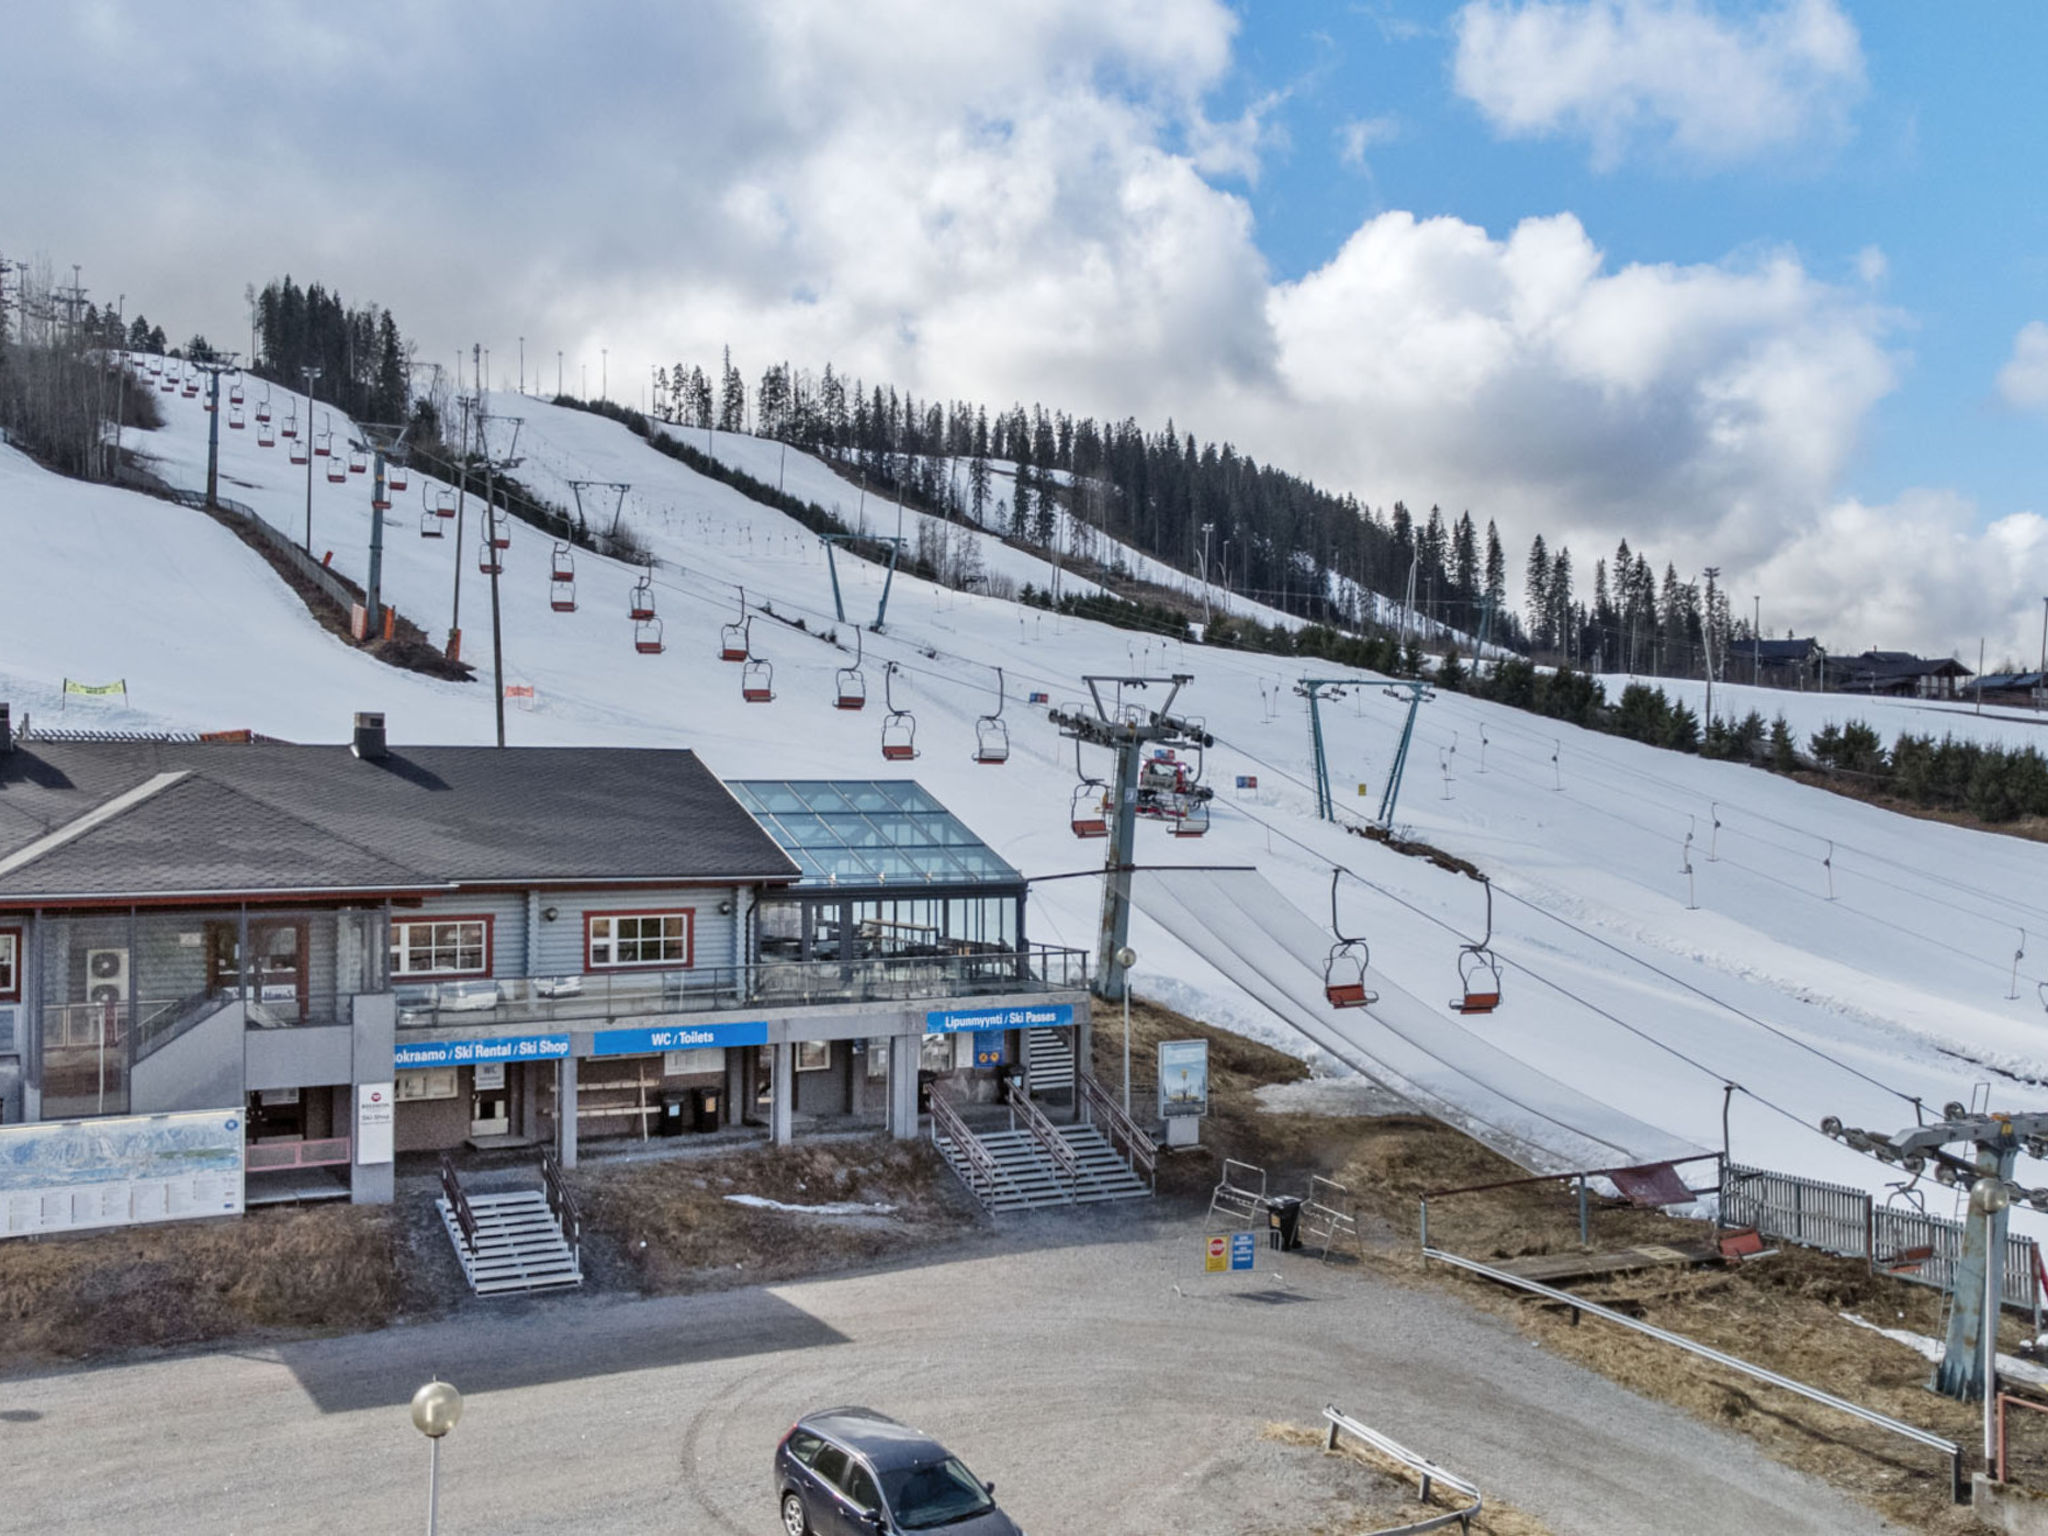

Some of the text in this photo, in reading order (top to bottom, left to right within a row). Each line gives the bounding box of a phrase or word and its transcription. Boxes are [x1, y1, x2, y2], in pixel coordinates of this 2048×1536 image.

[945, 1013, 1003, 1029] Lipunmyynti
[1009, 1012, 1024, 1025] Ski
[1026, 1011, 1057, 1023] Passes
[651, 1032, 671, 1046] WC
[679, 1030, 714, 1045] Toilets
[393, 1049, 447, 1064] okraamo
[454, 1045, 473, 1060] Ski
[475, 1043, 512, 1058] Rental
[519, 1041, 537, 1055] Ski
[539, 1040, 569, 1055] Shop
